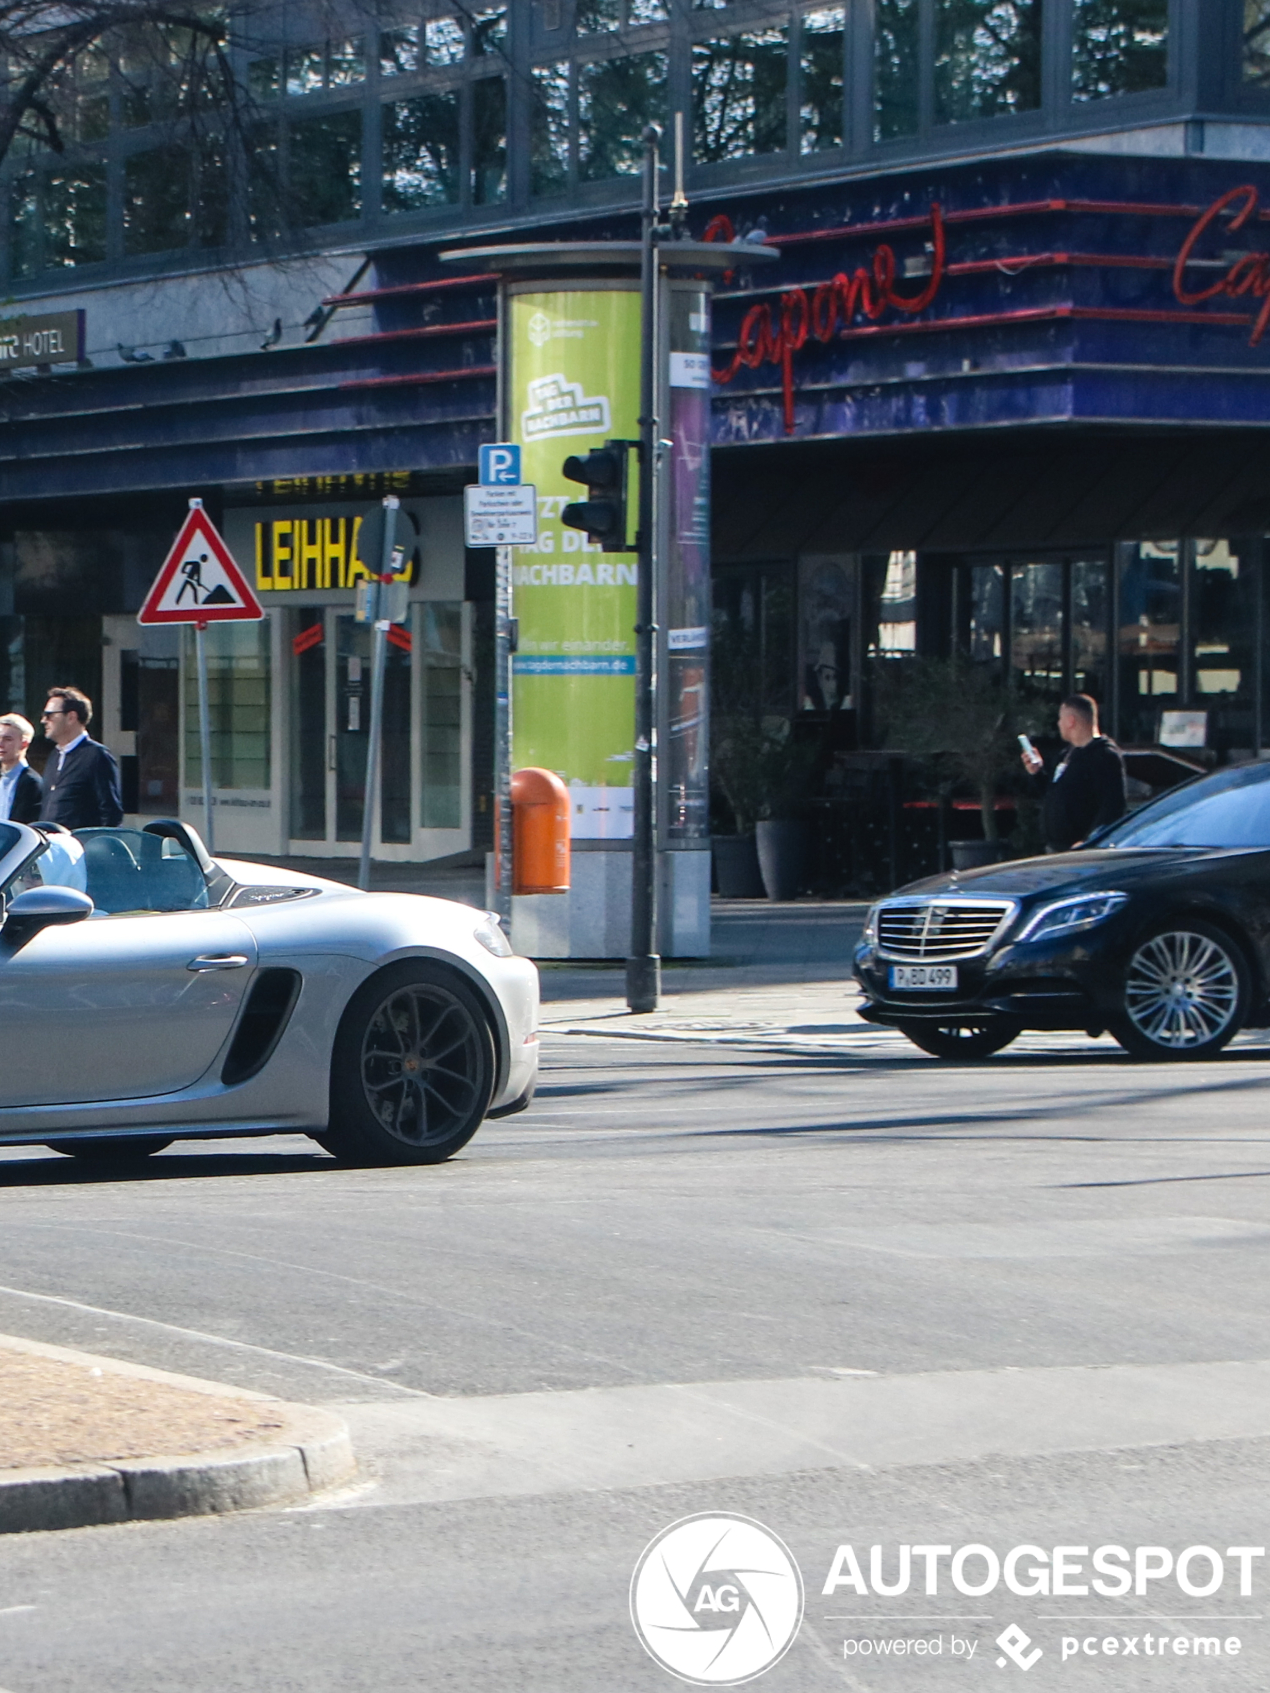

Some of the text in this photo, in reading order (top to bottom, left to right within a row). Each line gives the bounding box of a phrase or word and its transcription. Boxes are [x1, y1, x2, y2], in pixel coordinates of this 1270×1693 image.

[23, 329, 65, 356] HOTEL
[489, 449, 513, 482] P
[897, 968, 905, 985] P
[929, 968, 951, 985] 499
